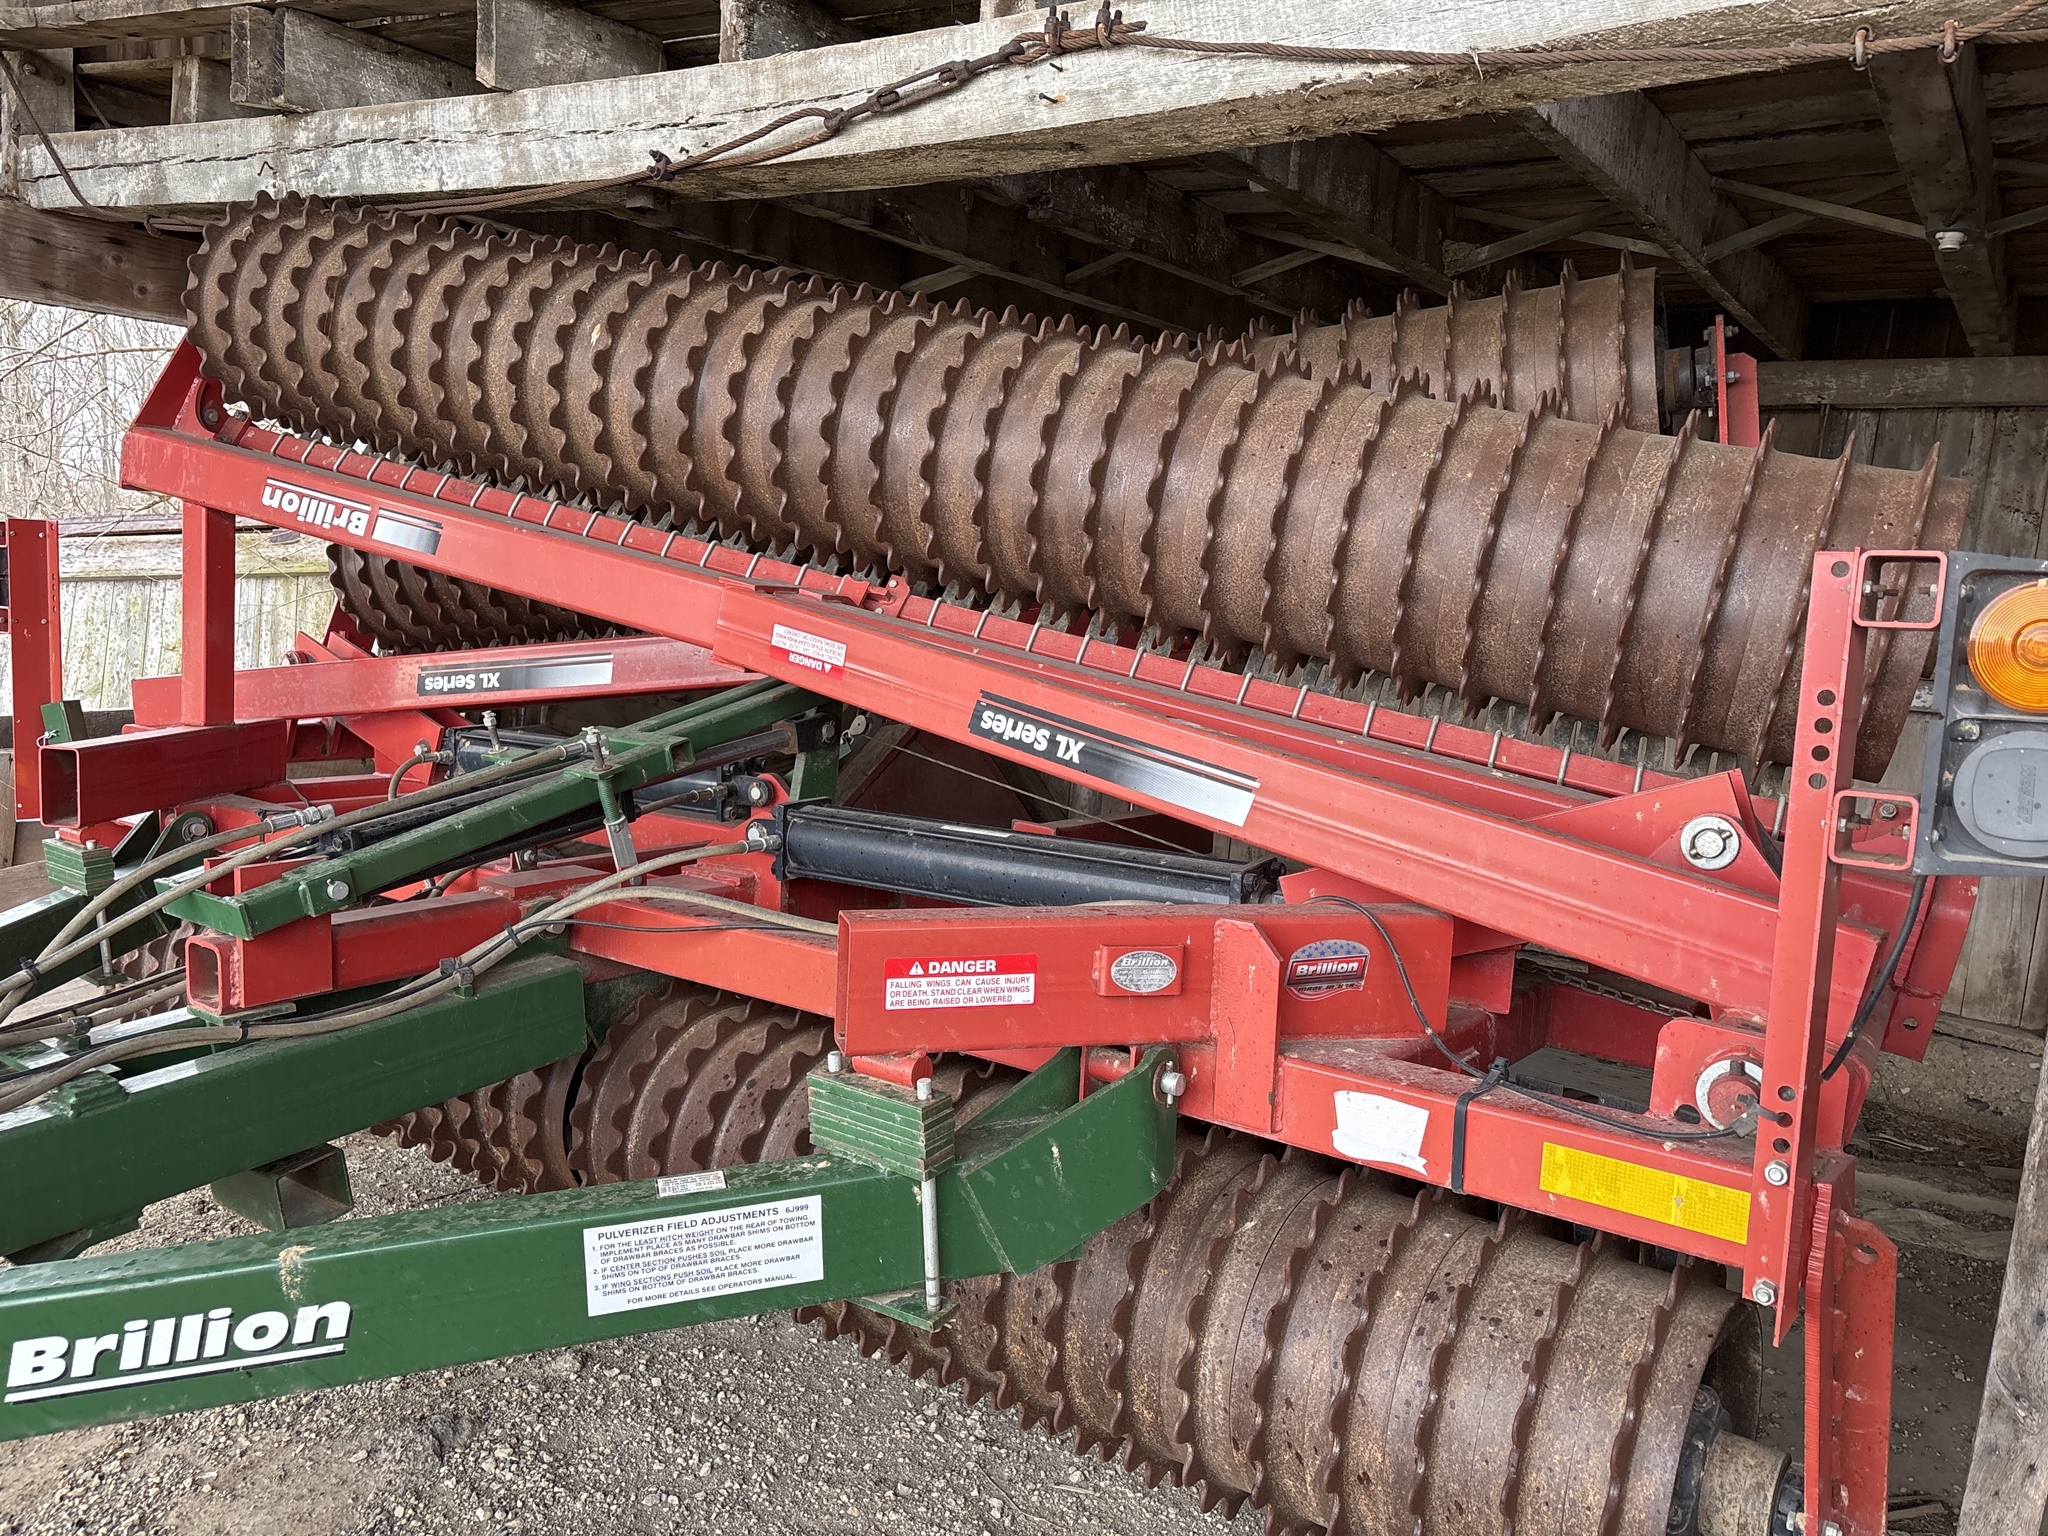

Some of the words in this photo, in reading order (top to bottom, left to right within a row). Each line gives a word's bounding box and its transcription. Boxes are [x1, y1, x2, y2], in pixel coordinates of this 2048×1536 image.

[262, 485, 369, 536] Brillion
[789, 652, 822, 671] DANGER
[424, 673, 475, 691] Series
[479, 672, 500, 688] XL
[980, 710, 1050, 751] Series
[1056, 734, 1085, 764] XL
[2018, 765, 2036, 824] Wesbar
[928, 960, 996, 974] DANGER
[1121, 958, 1169, 967] Brillion
[1296, 961, 1359, 976] Brillion
[890, 980, 922, 988] FALLING
[931, 988, 956, 996] STAND
[598, 1224, 664, 1240] PULVERIZER
[668, 1220, 697, 1231] FIELD
[701, 1208, 779, 1226] ADJUSTMENTS
[785, 1204, 809, 1213] 6J999
[634, 1237, 658, 1246] LEAST
[684, 1228, 714, 1240] WEIGHT
[779, 1215, 808, 1224] TOWING
[600, 1246, 644, 1257] IMPLEMENT
[646, 1242, 670, 1250] PLACE
[708, 1230, 745, 1242] DRAWBAR
[748, 1227, 770, 1236] SHIMS
[786, 1221, 816, 1230] BOTTOM
[613, 1251, 651, 1263] DRAWBAR
[653, 1248, 684, 1257] BRACES
[698, 1240, 736, 1250] POSSIBLE.
[602, 1272, 626, 1280] SHIMS
[670, 1256, 708, 1270] DRAWBAR
[710, 1254, 742, 1263] BRACES.
[610, 1263, 640, 1272] CENTER
[642, 1258, 675, 1268] SECTION
[678, 1250, 708, 1262] PUSHES
[729, 1245, 752, 1254] PLACE
[754, 1242, 776, 1250] MORE
[778, 1236, 814, 1246] DRAWBAR
[603, 1288, 626, 1296] SHIMS
[642, 1280, 674, 1290] BOTTOM
[688, 1273, 726, 1284] DRAWBAR
[728, 1268, 759, 1277] BRACES.
[610, 1280, 631, 1288] WING
[634, 1274, 671, 1285] SECTIONS
[674, 1270, 694, 1279] PUSH
[715, 1264, 739, 1272] PLACE
[741, 1260, 762, 1268] MORE
[764, 1254, 800, 1264] DRAWBAR
[645, 1293, 667, 1301] MORE
[669, 1288, 700, 1298] DETAILS
[718, 1278, 762, 1289] OPERATORS
[764, 1274, 796, 1282] MANUAL.
[6, 1301, 352, 1388] Brillion
